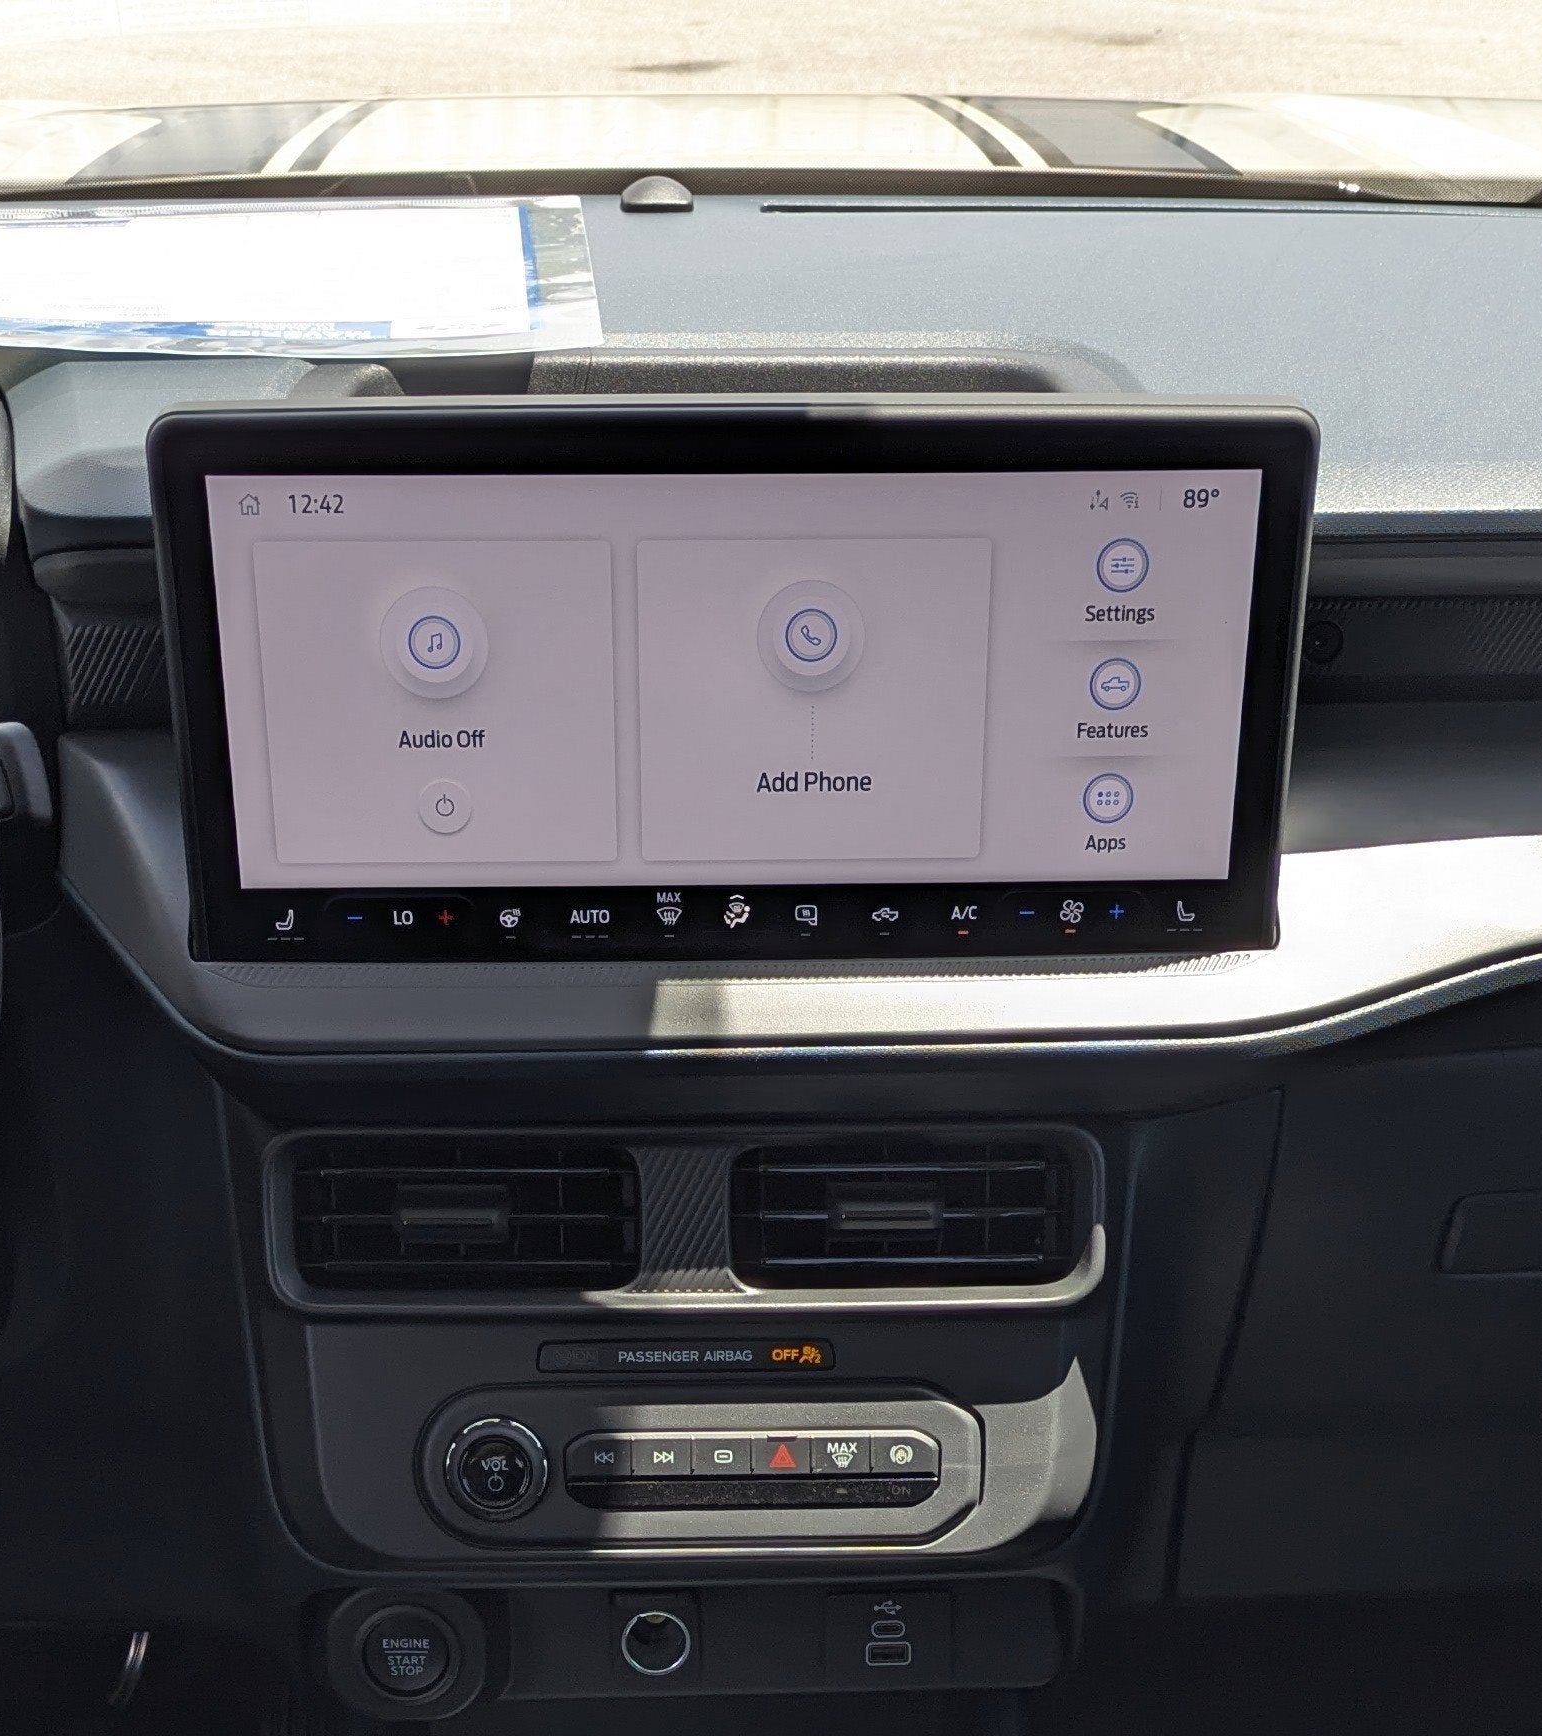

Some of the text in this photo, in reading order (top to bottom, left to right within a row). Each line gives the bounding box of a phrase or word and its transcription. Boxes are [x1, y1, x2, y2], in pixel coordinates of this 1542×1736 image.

[288, 493, 345, 514] 12:42
[1084, 604, 1156, 625] Settings
[1076, 722, 1149, 739] Features
[398, 729, 486, 749] Audio Off
[756, 771, 872, 793] Add Phone
[1084, 834, 1126, 853] Apps
[656, 892, 682, 904] MAX
[393, 910, 414, 926] LO
[570, 909, 610, 925] AUTO
[951, 905, 978, 921] A/C
[618, 1348, 800, 1363] PASSENGER AIRBAG OFF
[827, 1442, 858, 1453] MAX
[480, 1459, 509, 1472] VOL
[382, 1638, 430, 1649] ENGINE
[387, 1655, 427, 1666] START
[390, 1665, 424, 1676] STOP
